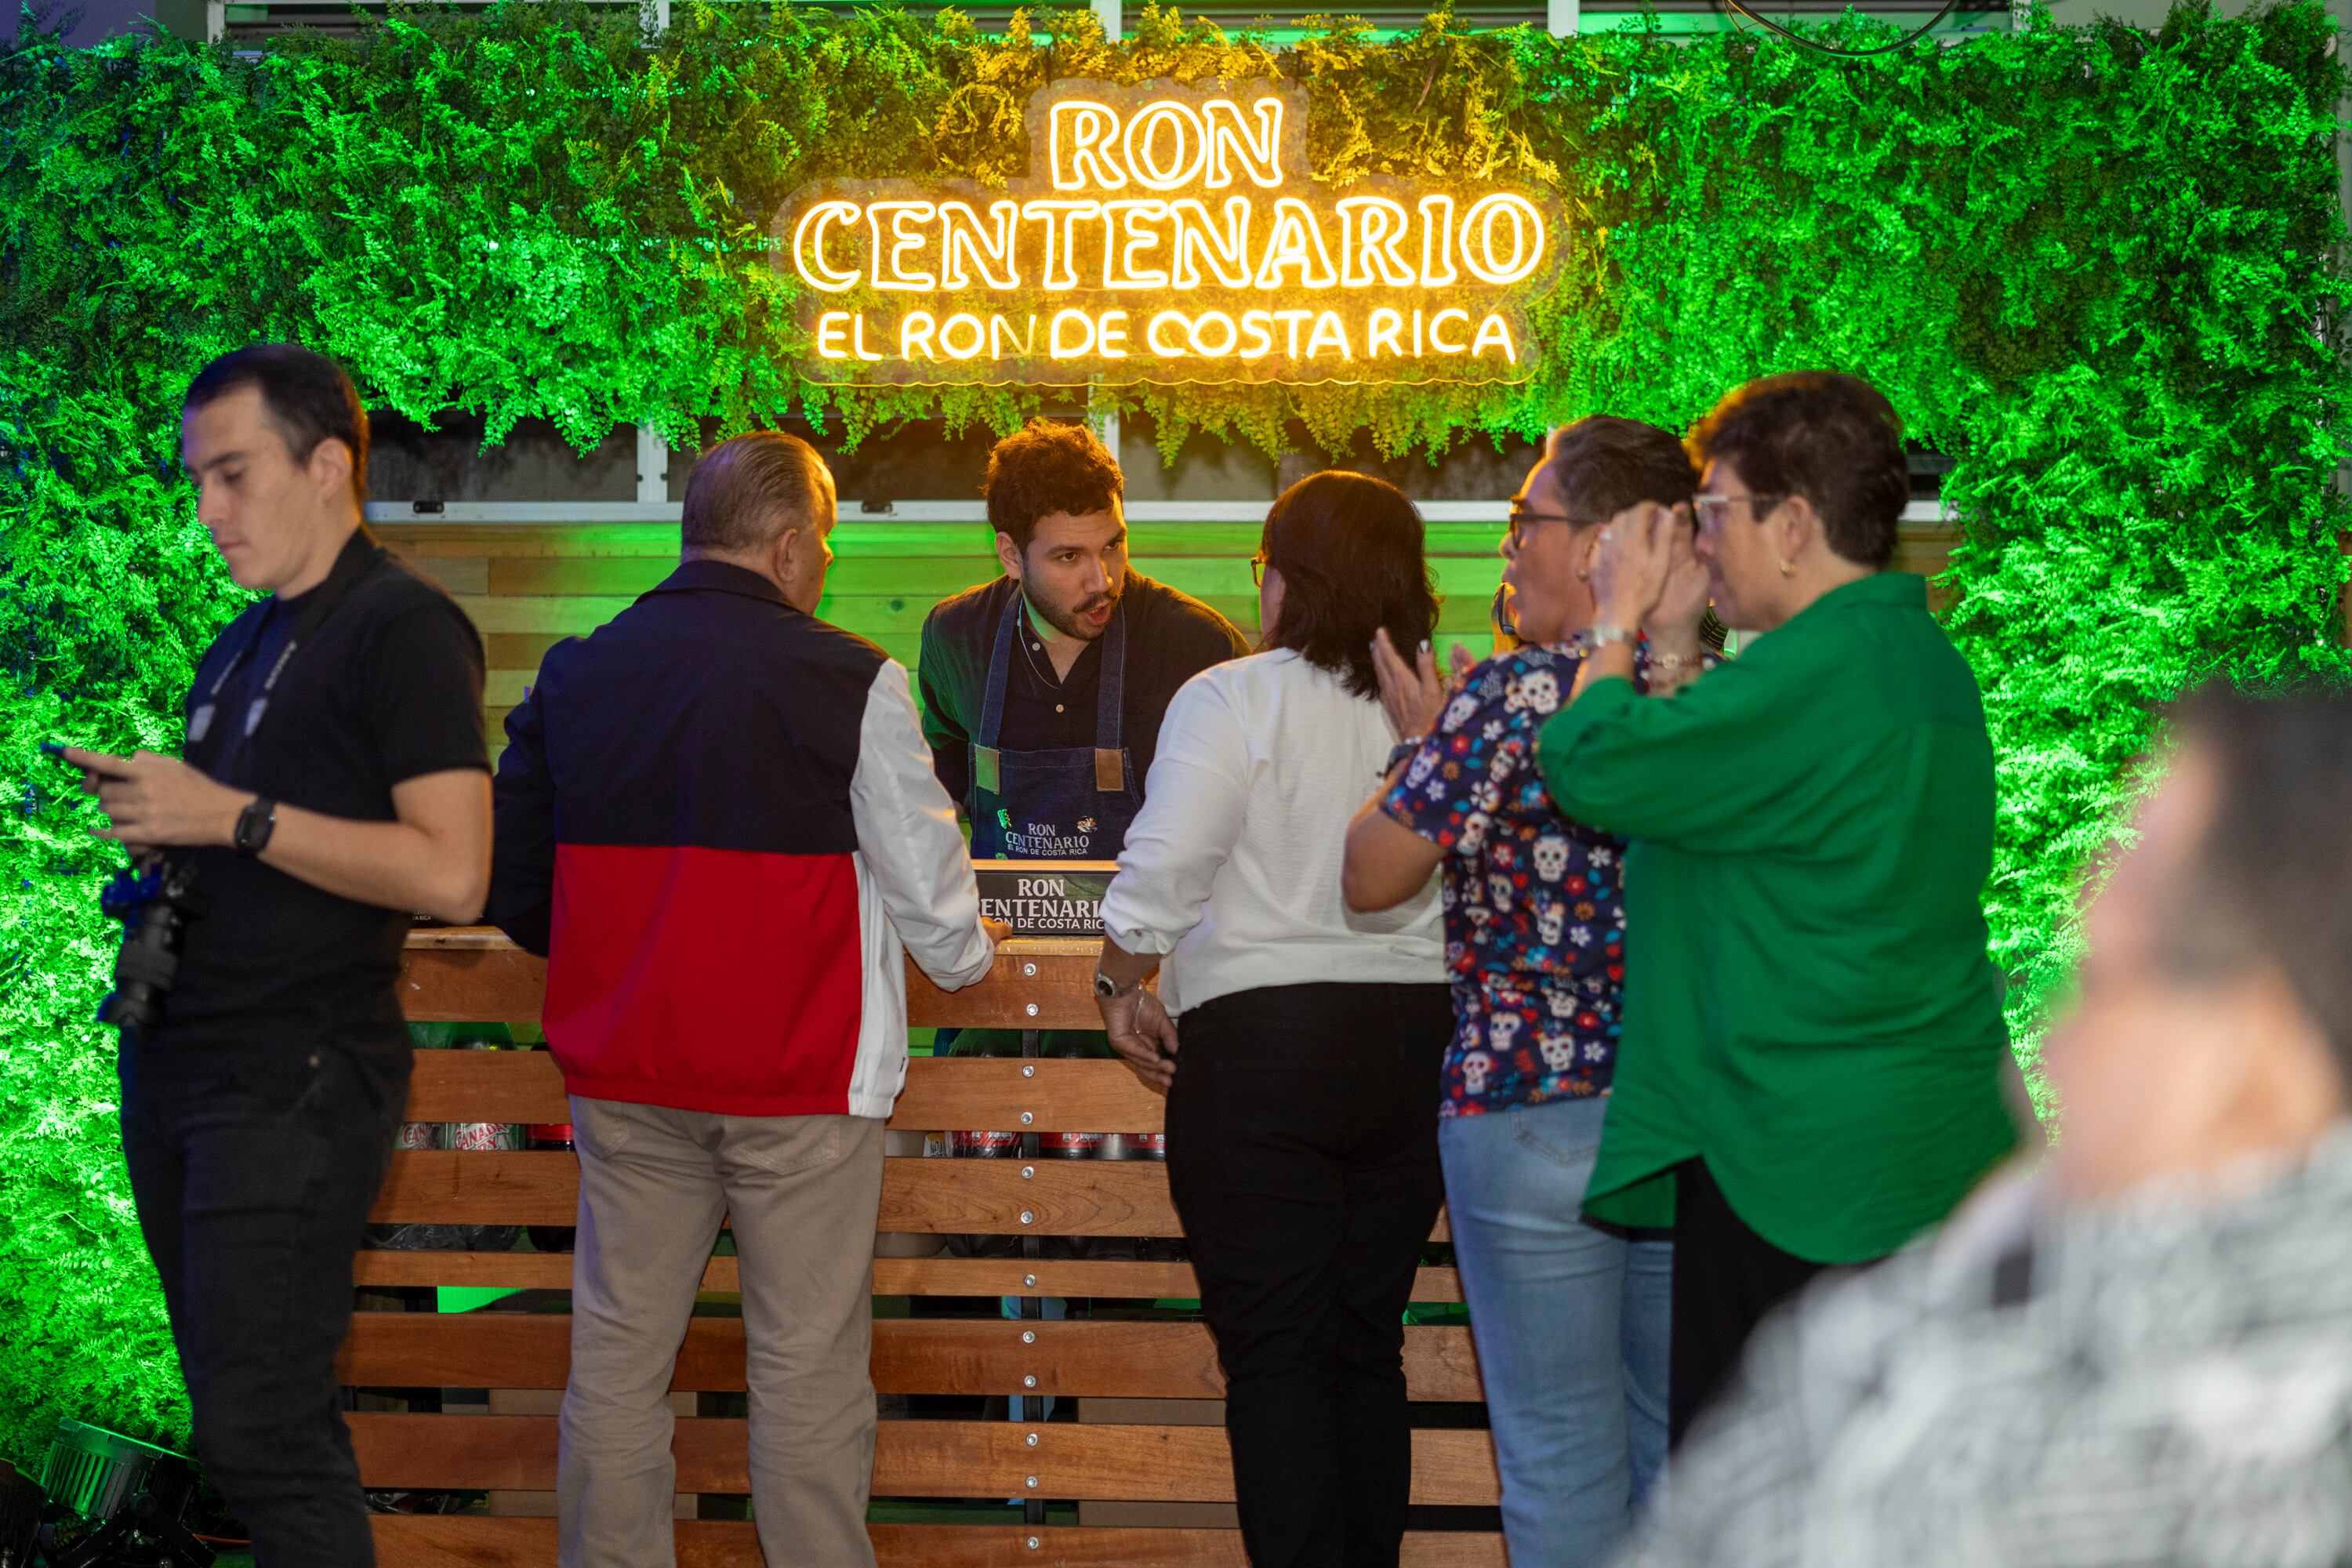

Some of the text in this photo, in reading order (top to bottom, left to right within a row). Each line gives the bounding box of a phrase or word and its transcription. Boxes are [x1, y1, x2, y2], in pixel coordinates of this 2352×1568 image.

[1049, 97, 1283, 191] RON
[793, 193, 1545, 292] CENTENARIO
[818, 308, 1516, 364] EL RON DE COSTA RICA
[1028, 823, 1056, 837] RON
[1005, 831, 1090, 849] CENTENARIO
[1015, 846, 1028, 855] RON
[1018, 879, 1065, 897] RON
[980, 898, 1099, 917] ENTENARI
[1018, 918, 1034, 928] DE
[1038, 919, 1080, 929] COSTA
[1083, 920, 1104, 929] RIC
[453, 1123, 509, 1150] CANADA
